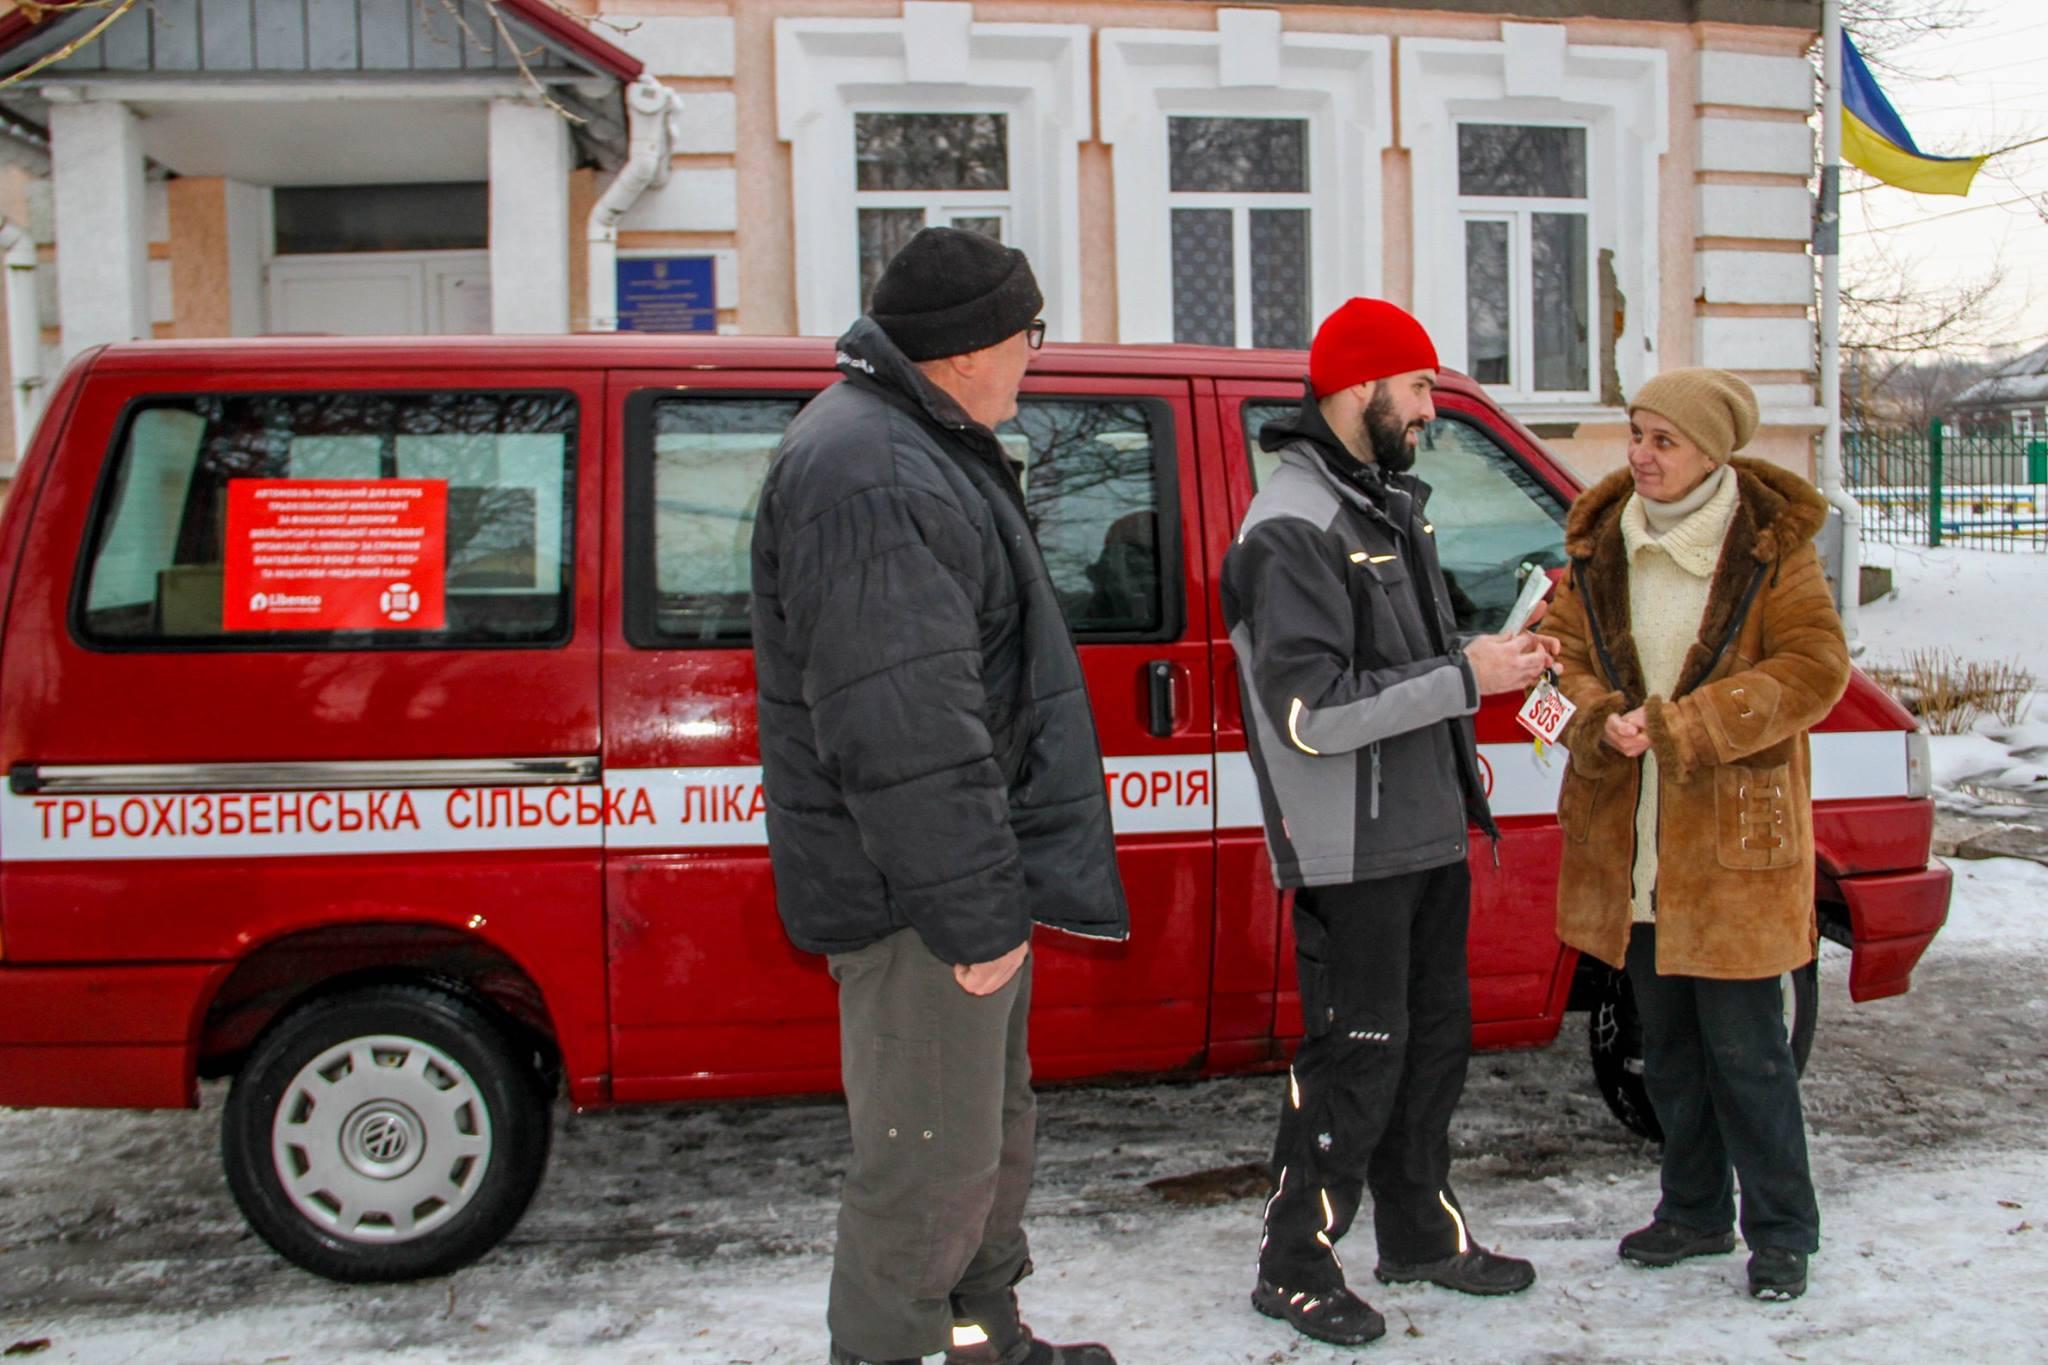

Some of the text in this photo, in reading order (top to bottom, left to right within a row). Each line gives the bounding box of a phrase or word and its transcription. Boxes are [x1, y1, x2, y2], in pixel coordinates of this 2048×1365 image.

[1528, 700, 1561, 734] SOS
[33, 788, 420, 839] ТРЬОХІЗБЕНСЬКА
[446, 785, 657, 829] СІЛЬСЬКА
